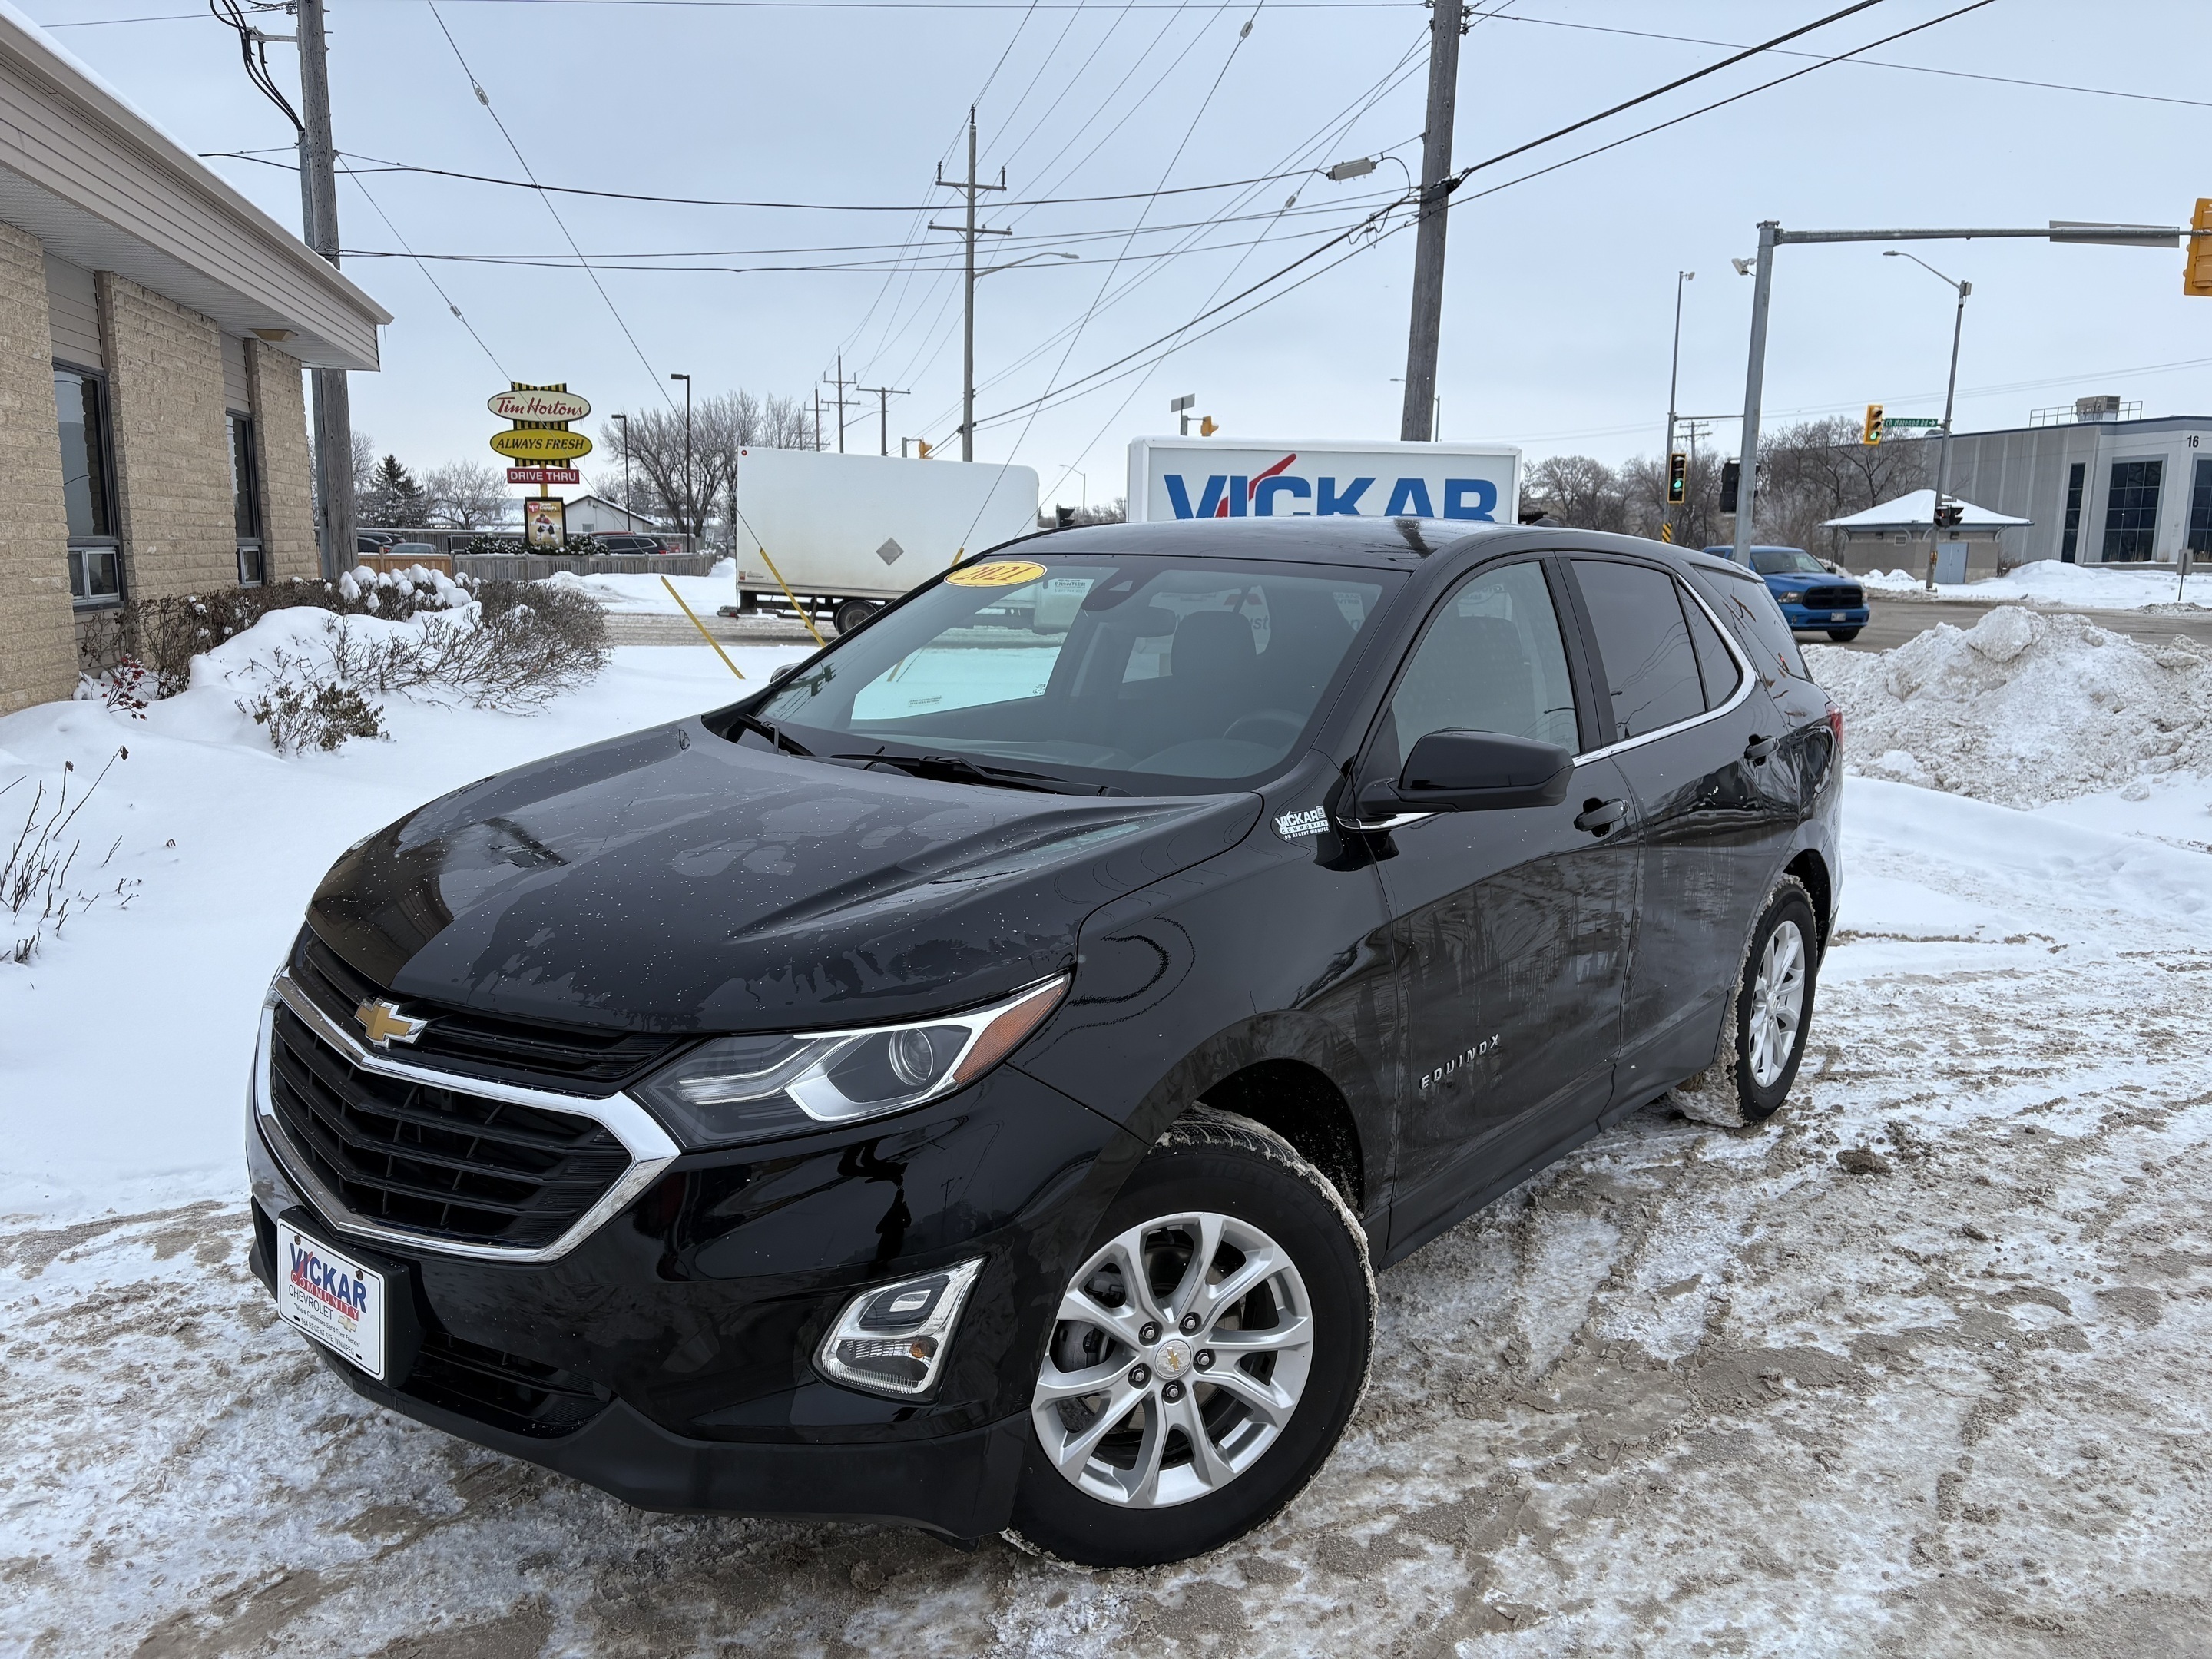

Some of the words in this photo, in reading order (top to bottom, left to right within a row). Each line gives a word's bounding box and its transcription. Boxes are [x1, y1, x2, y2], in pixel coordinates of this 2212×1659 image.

[496, 396, 524, 414] Tim
[528, 397, 583, 416] Hortons
[495, 439, 542, 449] ALWAYS
[546, 439, 585, 450] FRESH
[2187, 435, 2200, 448] 16
[510, 471, 544, 481] DRIVE
[545, 472, 577, 482] THRU
[1164, 473, 1498, 522] VICKAR
[953, 565, 1037, 581] 2021
[1275, 810, 1320, 827] VICKAR
[1281, 821, 1326, 833] COMMUNITY
[1310, 826, 1330, 835] WINNIPEG
[1420, 1033, 1499, 1090] EQUINOX
[290, 1242, 367, 1314] VICKAR
[289, 1284, 333, 1320] CHEVROLET
[292, 1273, 359, 1320] COMMUNITY
[306, 1310, 326, 1326] Customers
[326, 1322, 336, 1333] Send
[336, 1327, 345, 1339] Their
[309, 1321, 325, 1337] REGENT
[334, 1337, 355, 1356] WINNIPEG
